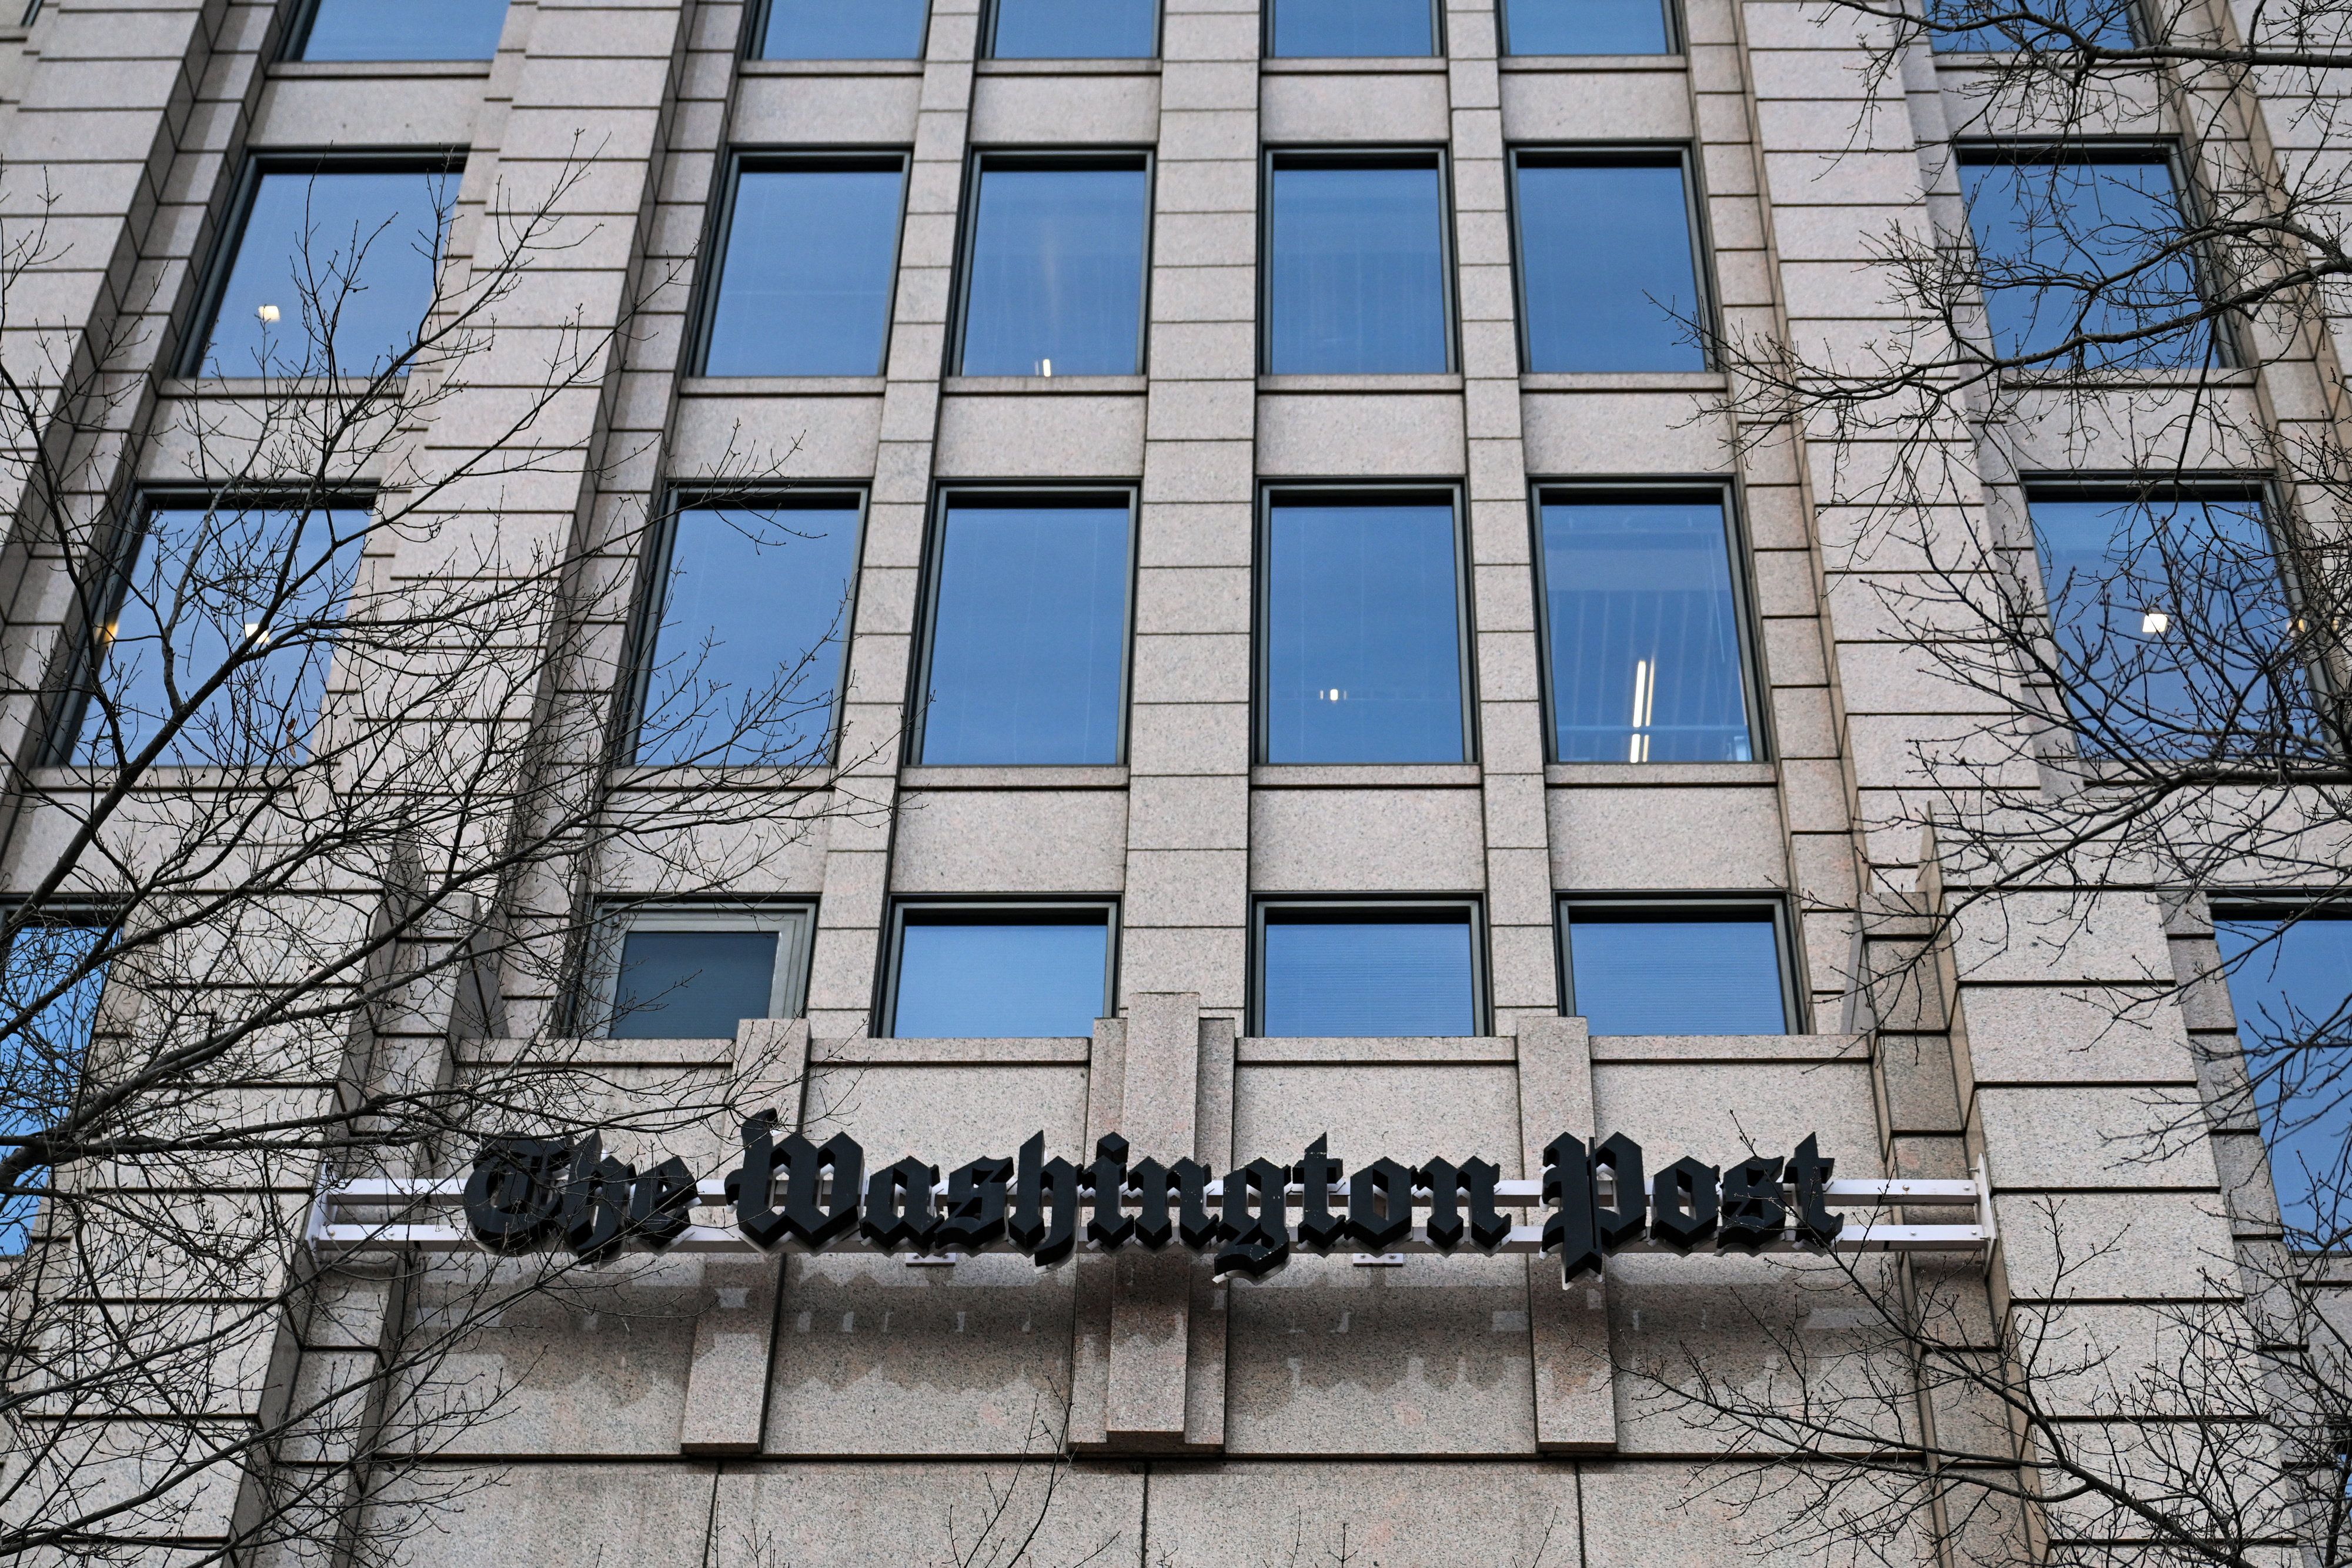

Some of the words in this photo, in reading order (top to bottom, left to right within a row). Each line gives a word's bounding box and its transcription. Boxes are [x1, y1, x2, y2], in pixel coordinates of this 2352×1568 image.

[463, 1129, 700, 1264] The
[724, 1107, 1512, 1281] Washington
[1540, 1131, 1845, 1283] Post
